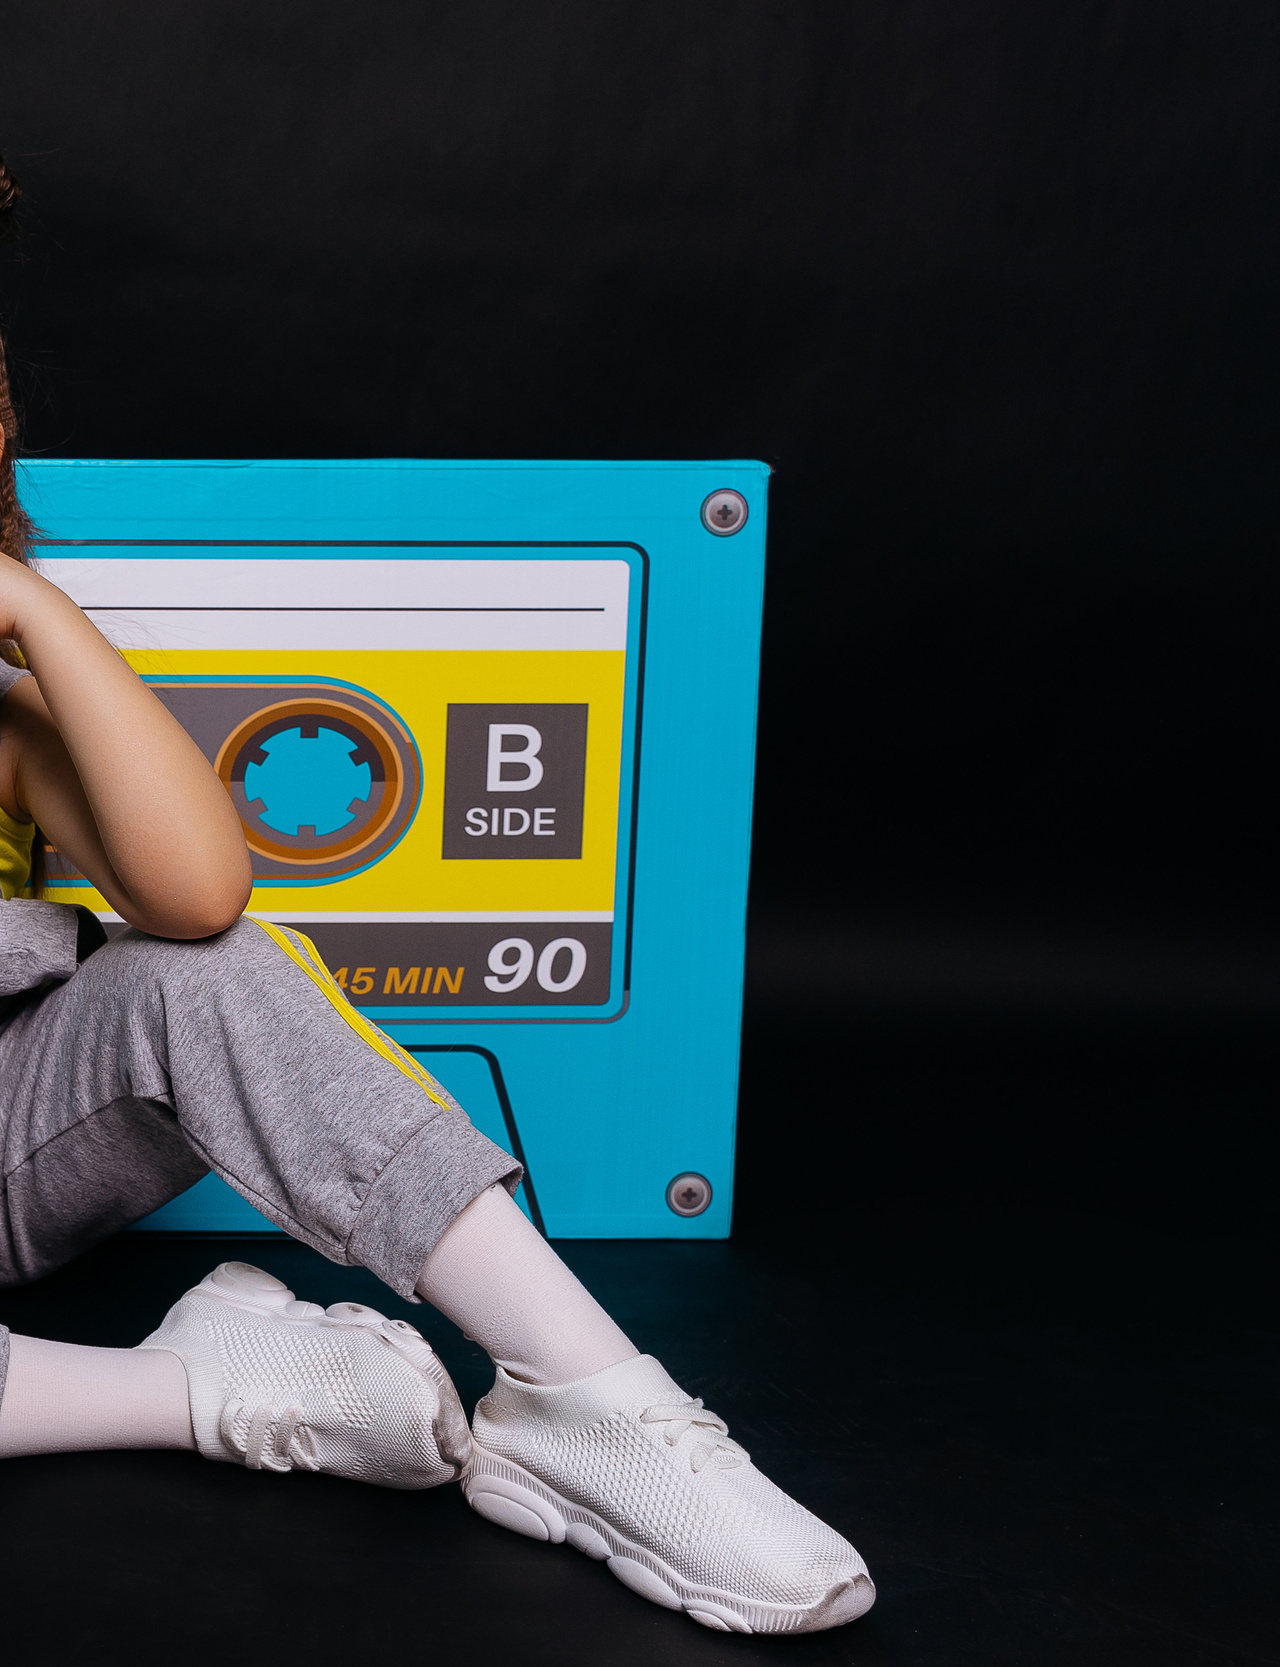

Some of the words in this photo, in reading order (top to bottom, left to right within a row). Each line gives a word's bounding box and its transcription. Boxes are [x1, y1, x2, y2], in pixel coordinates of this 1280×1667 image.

[486, 723, 545, 793] B
[464, 807, 557, 837] SIDE
[332, 966, 376, 995] 45
[382, 966, 465, 995] MIN
[483, 937, 588, 993] 90
